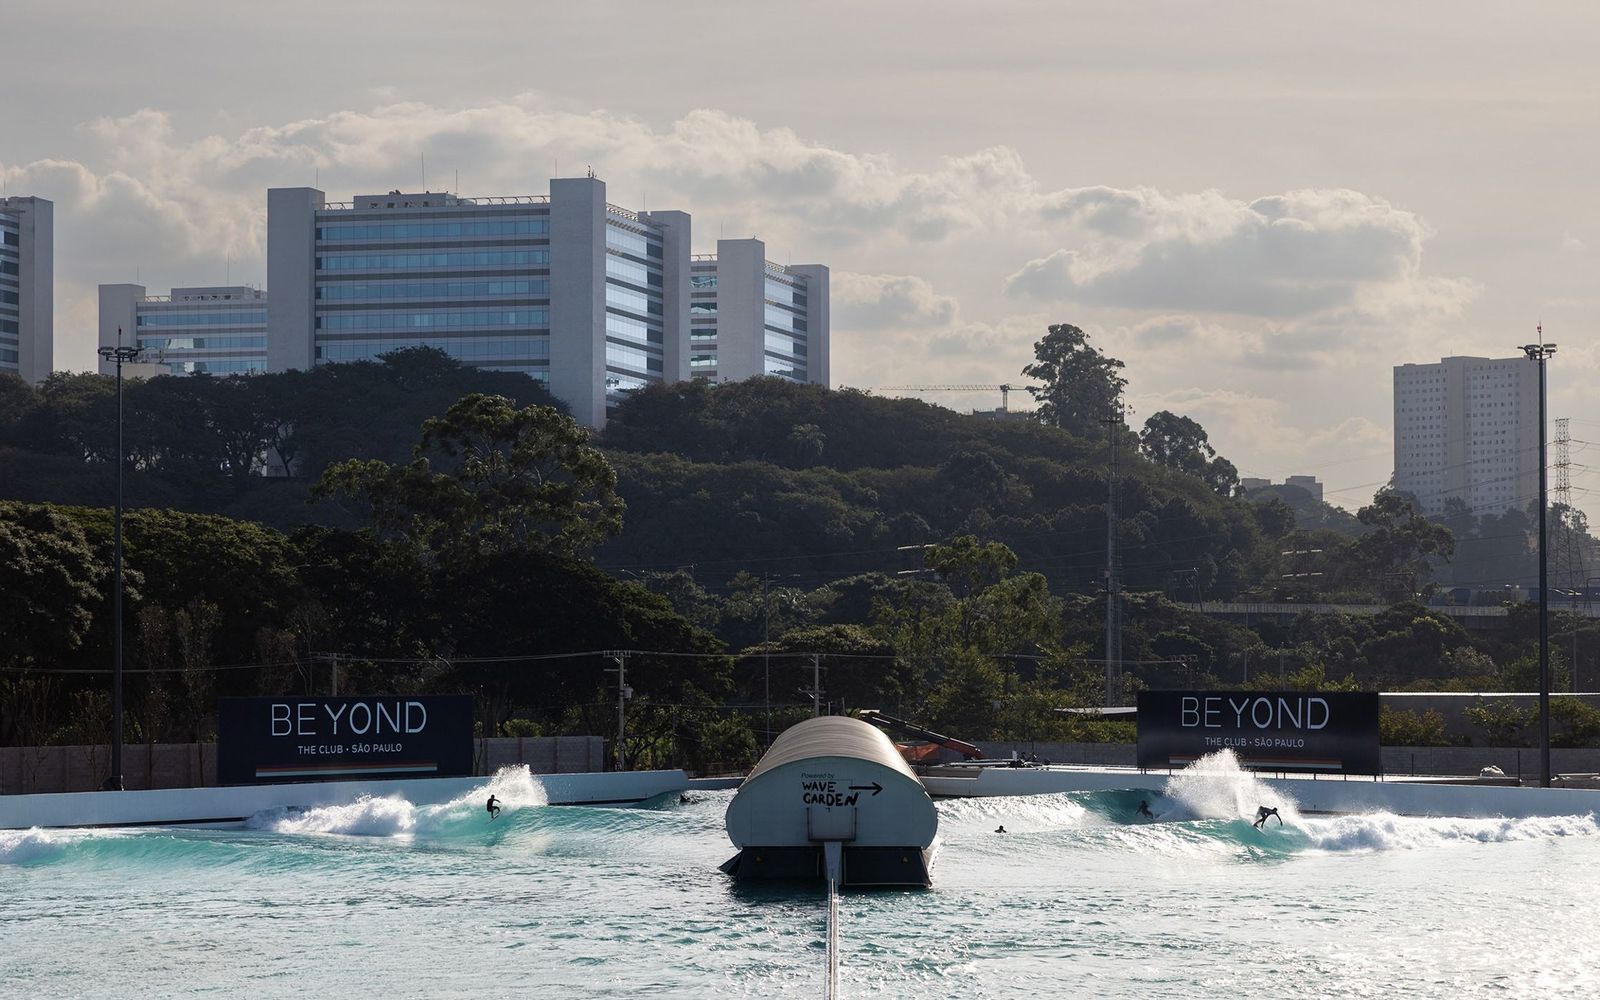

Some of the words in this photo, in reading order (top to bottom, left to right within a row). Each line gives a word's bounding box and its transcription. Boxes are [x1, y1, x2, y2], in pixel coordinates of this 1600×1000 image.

[271, 701, 427, 736] BEYOND
[1181, 697, 1330, 729] BEYOND
[1205, 737, 1222, 746] THE
[1224, 737, 1247, 747] CLUB
[1254, 737, 1273, 748] SÃO
[1275, 739, 1304, 748] PAULO
[298, 745, 316, 755] THE
[319, 745, 343, 754] CLUB
[351, 743, 371, 753] SÃO
[373, 743, 402, 753] PAULO
[827, 772, 835, 780] by
[802, 781, 837, 793] WAVE
[803, 792, 859, 807] GARDEN
